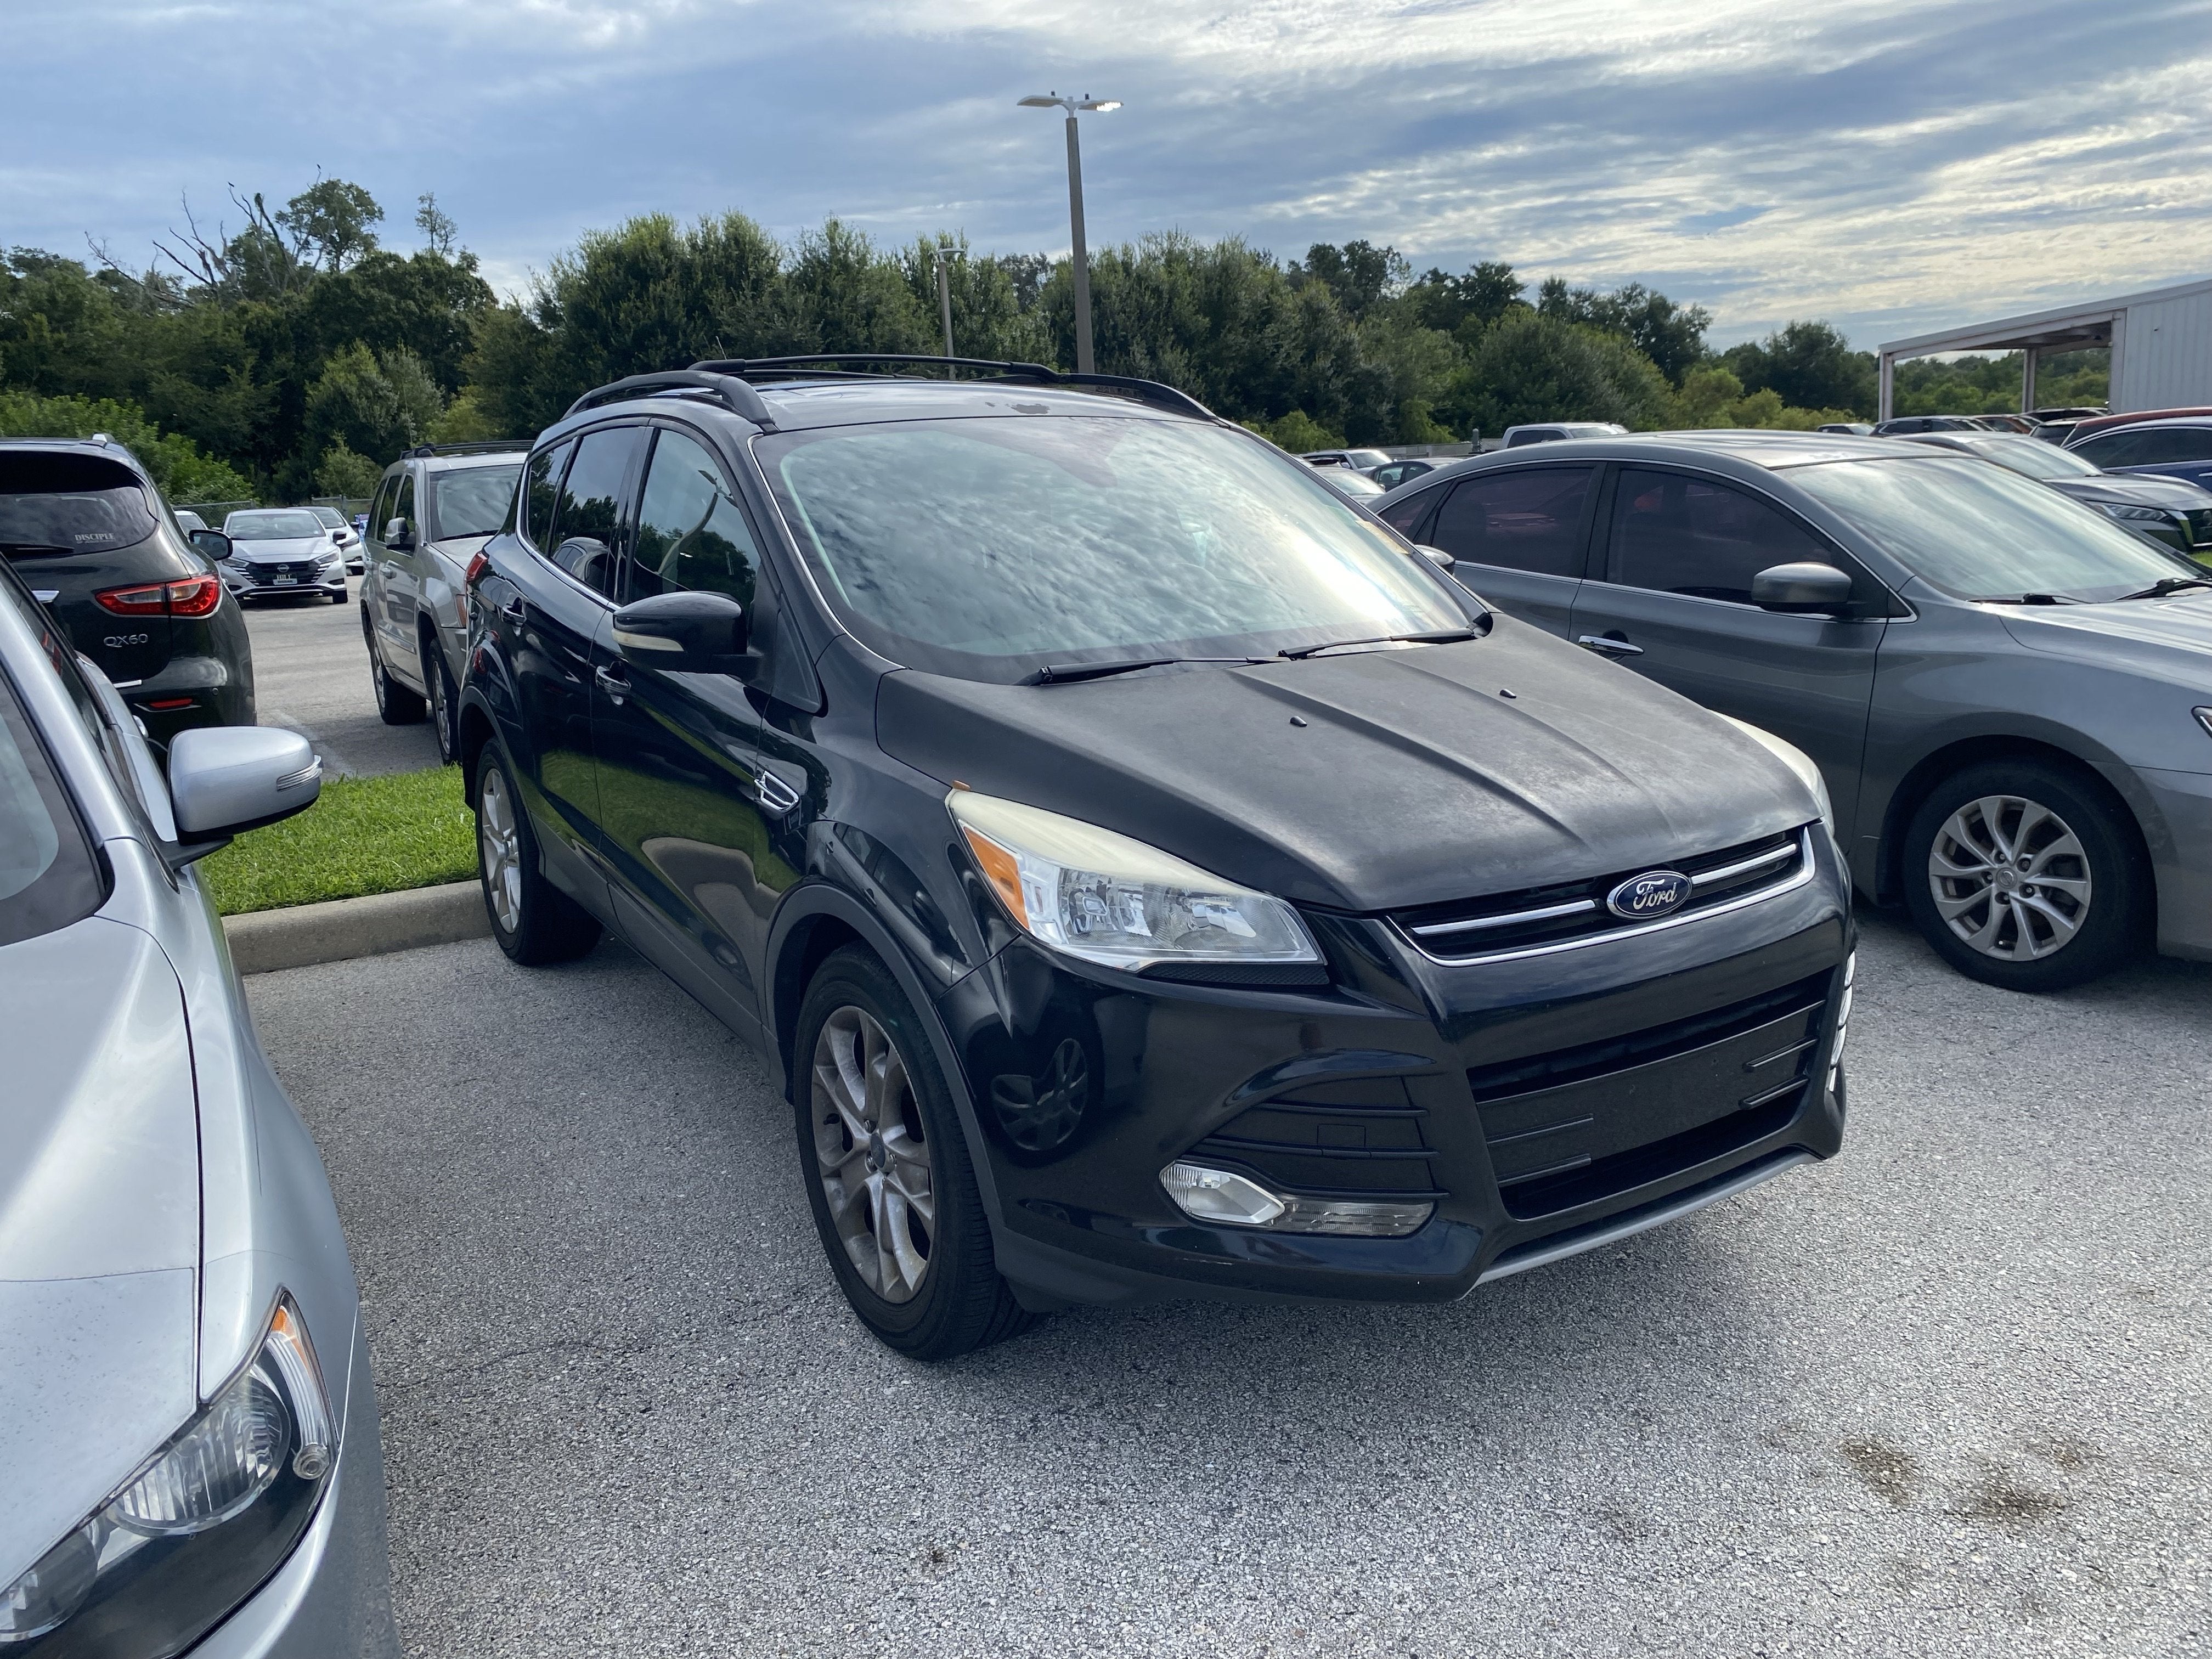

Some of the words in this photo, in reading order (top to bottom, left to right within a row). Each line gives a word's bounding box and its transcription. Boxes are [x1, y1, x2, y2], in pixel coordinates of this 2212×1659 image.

[75, 533, 115, 541] DISCIPLE
[103, 634, 148, 647] QX60
[1633, 879, 1678, 910] Ford
